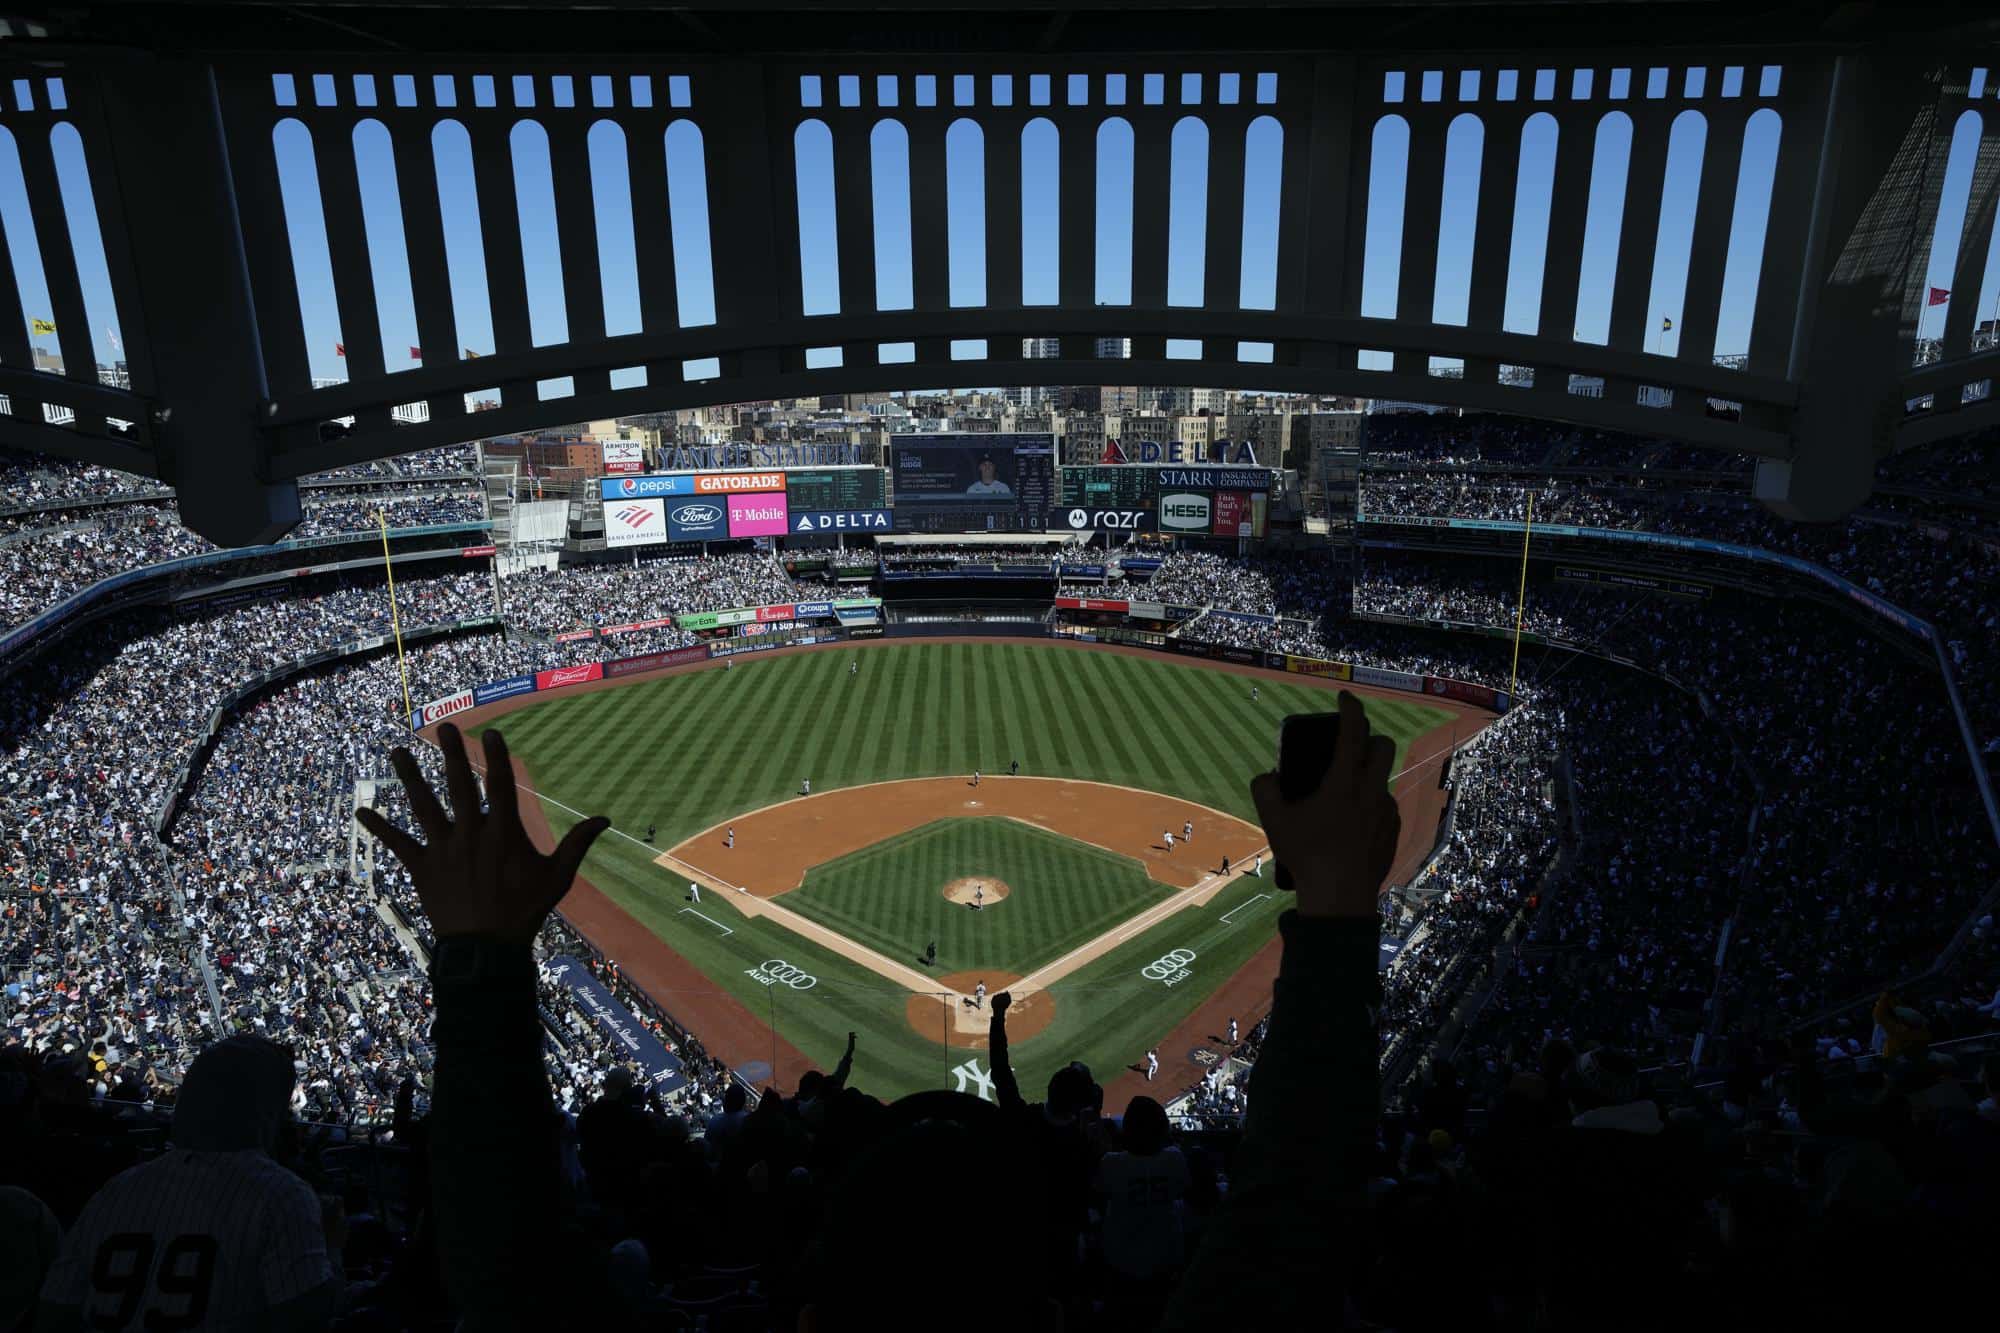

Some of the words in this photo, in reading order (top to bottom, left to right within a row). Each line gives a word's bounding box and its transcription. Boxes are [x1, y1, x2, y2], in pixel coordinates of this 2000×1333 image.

[657, 443, 750, 471] YANKEE
[759, 443, 861, 466] STADIUM
[1140, 440, 1257, 464] DELTA
[640, 478, 675, 493] pepsi
[700, 475, 780, 490] GATORADE
[1160, 470, 1214, 486] STARR
[680, 507, 713, 522] Ford
[1164, 504, 1207, 518] HESS
[819, 512, 887, 528] DELTA
[1093, 511, 1145, 528] razr
[807, 604, 828, 613] coupa
[699, 618, 717, 626] Eats
[424, 693, 473, 722] Canon
[744, 968, 777, 986] Audi
[1163, 968, 1193, 988] Audi
[93, 1231, 219, 1331] 99
